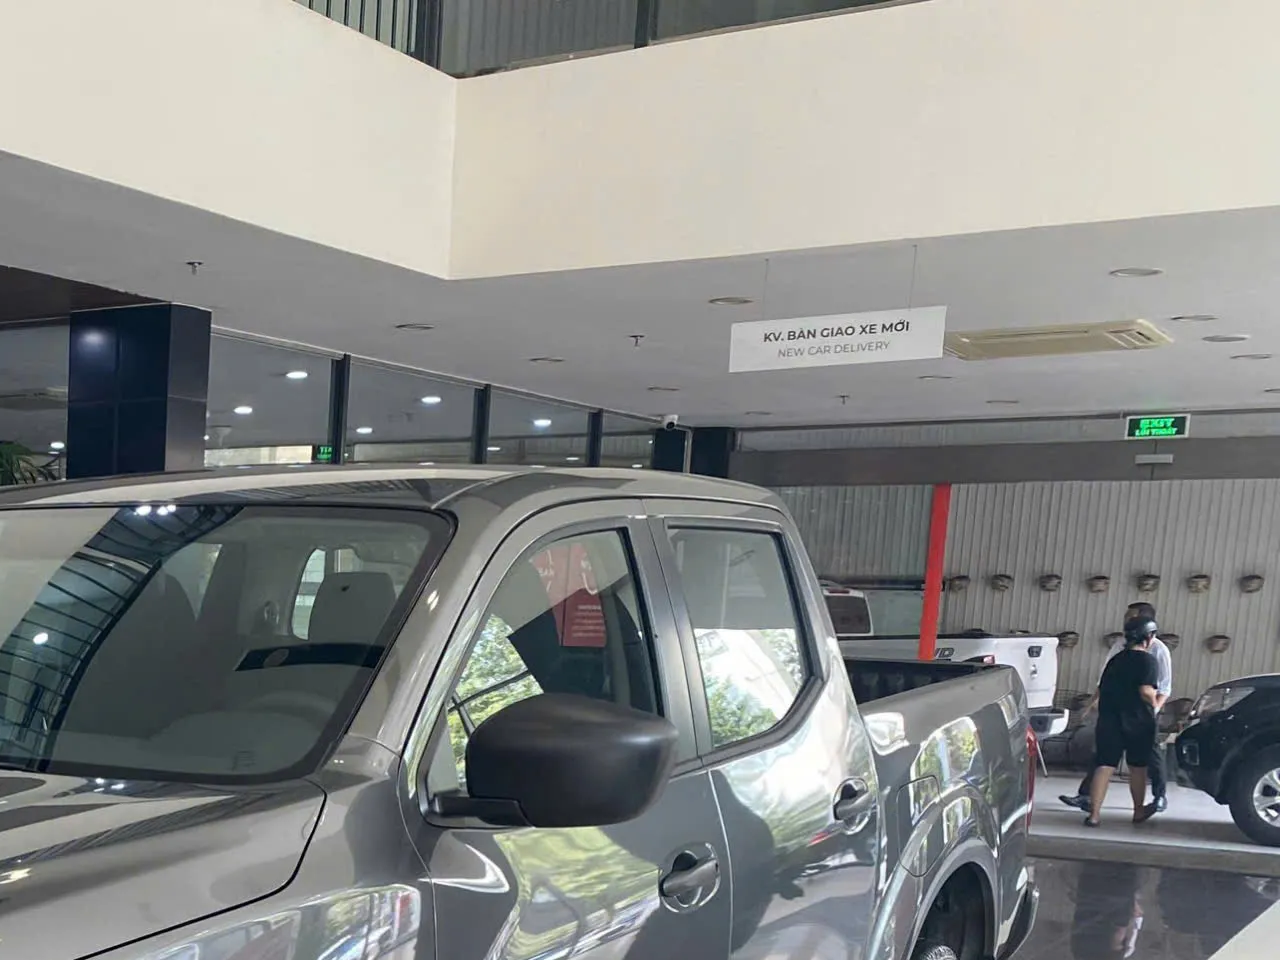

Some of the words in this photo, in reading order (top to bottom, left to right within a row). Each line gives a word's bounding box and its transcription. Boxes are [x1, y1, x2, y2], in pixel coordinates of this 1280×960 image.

[764, 331, 784, 342] KV.
[787, 328, 817, 341] BÀN
[820, 325, 856, 338] GIAO
[859, 323, 877, 335] XE
[881, 319, 910, 333] MỚI
[778, 347, 804, 358] NEW
[808, 345, 831, 356] CAR
[834, 341, 890, 354] DELIVERY
